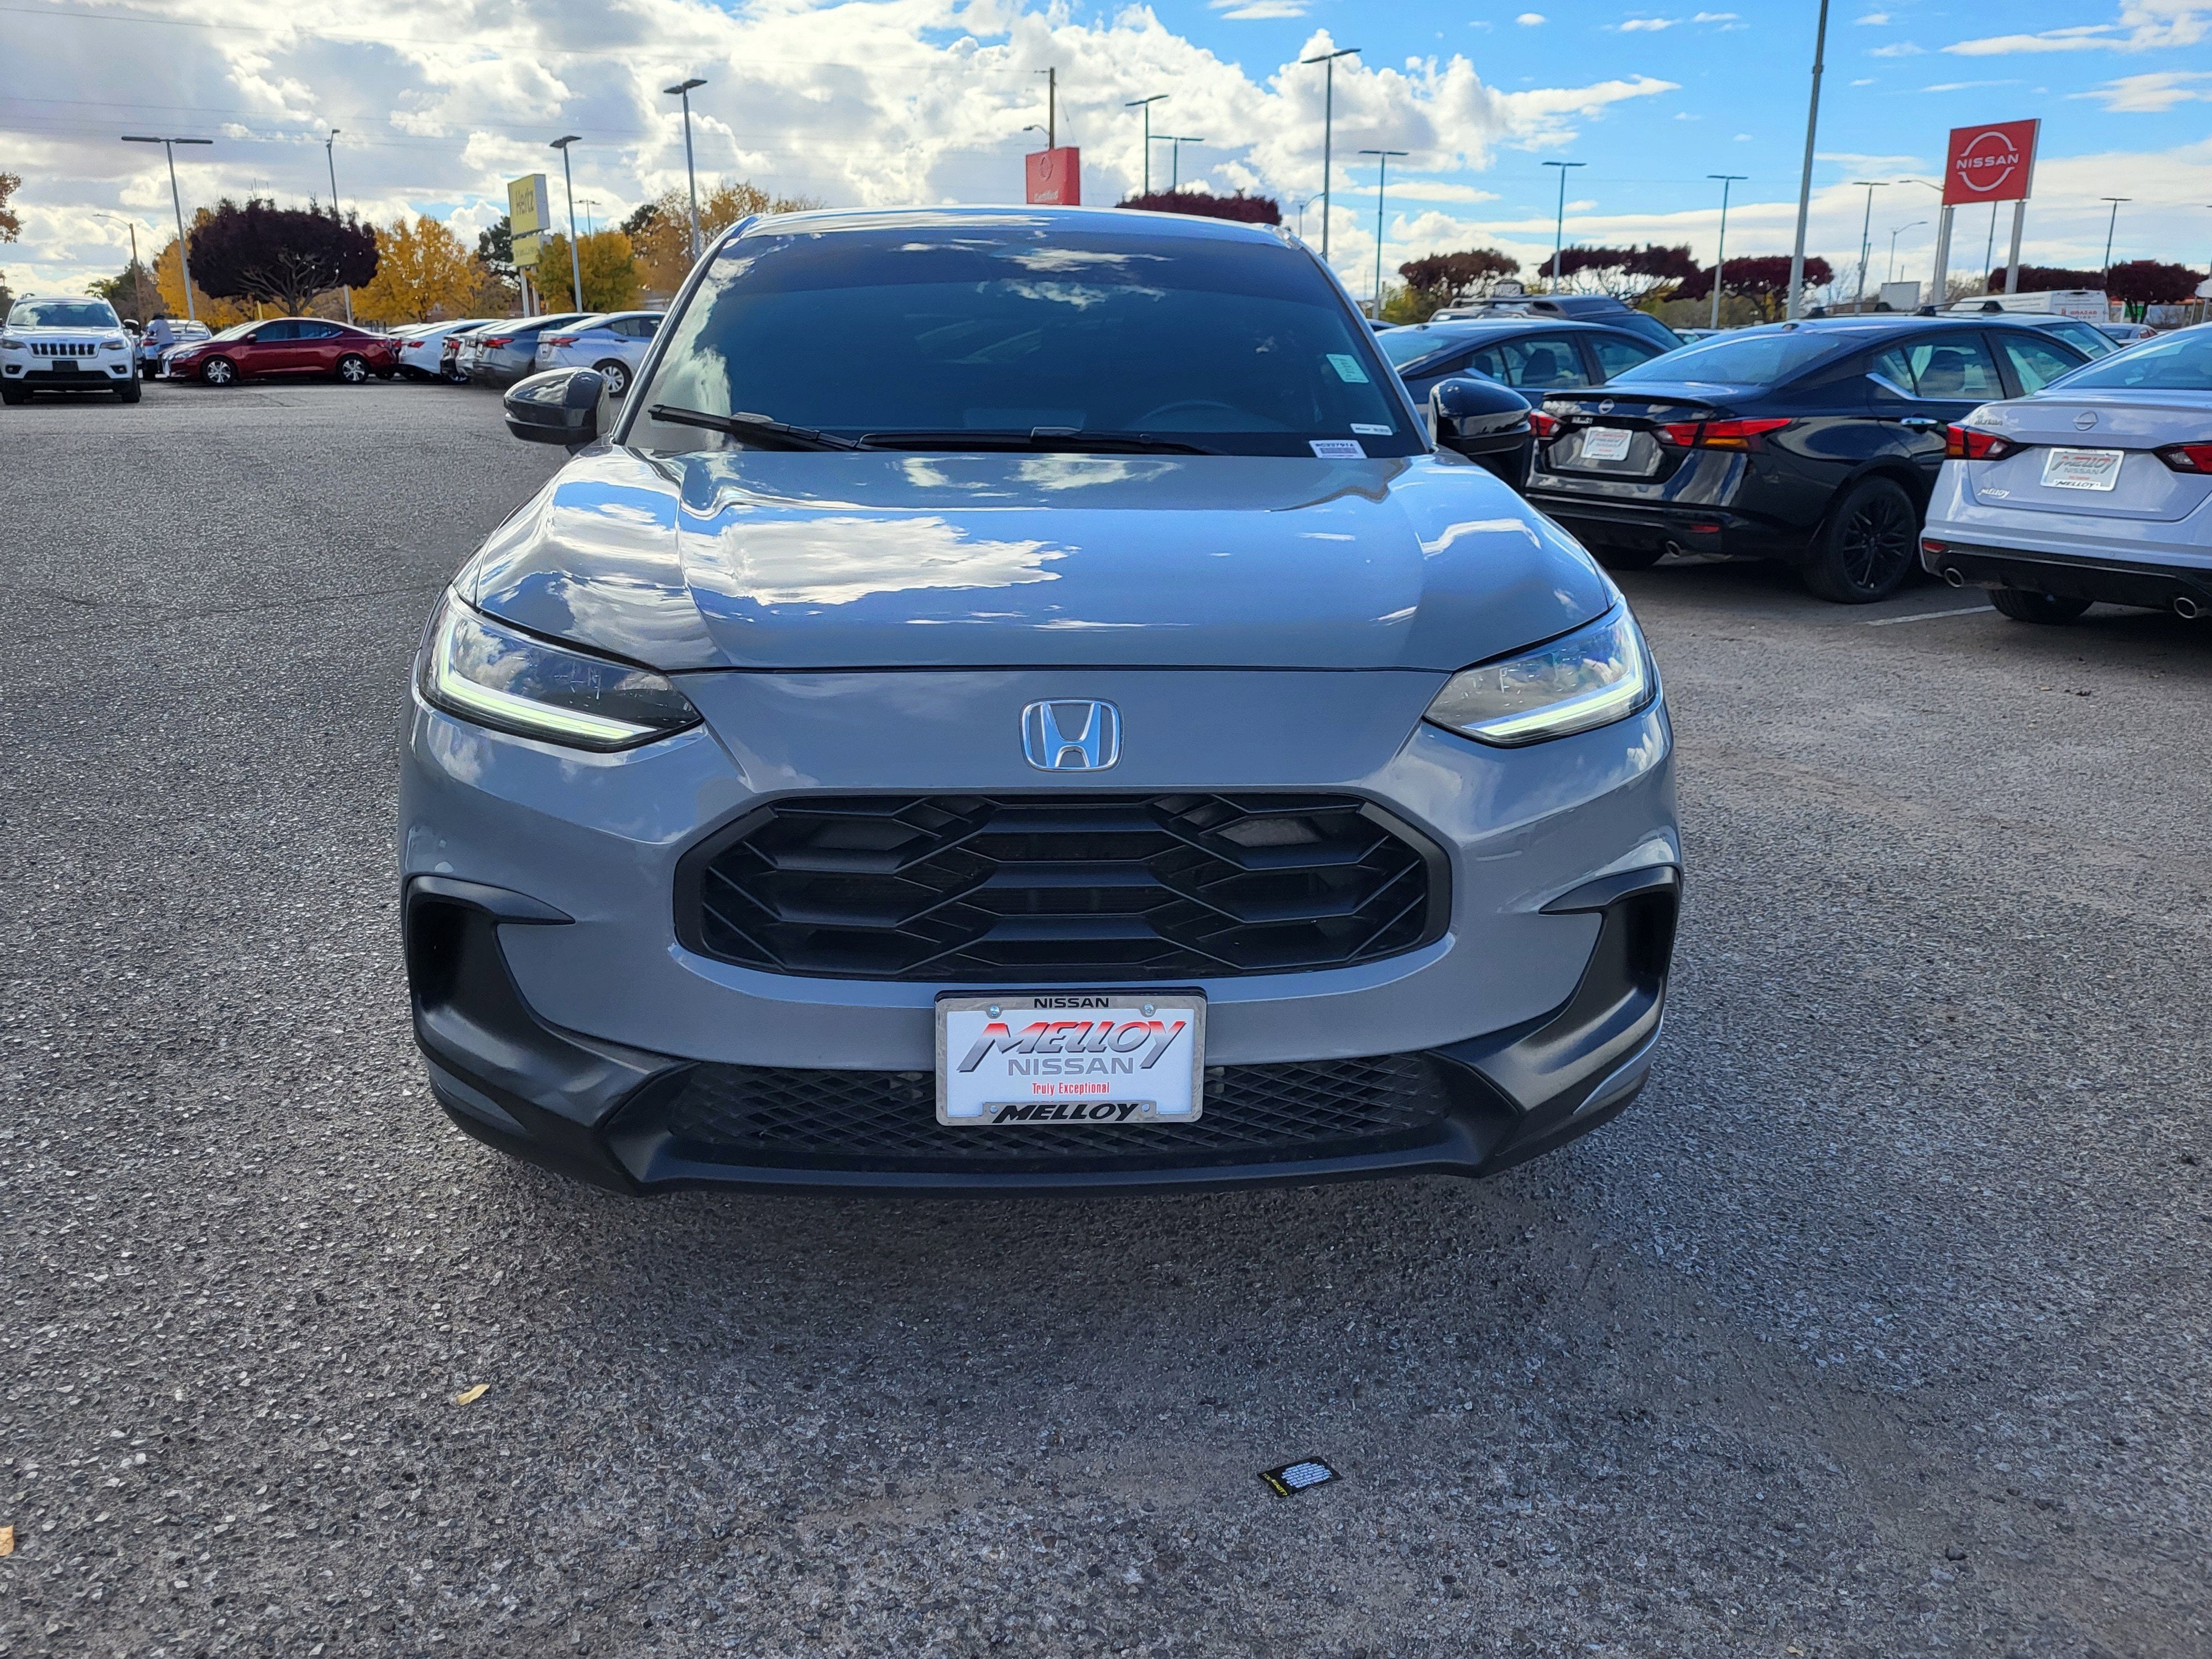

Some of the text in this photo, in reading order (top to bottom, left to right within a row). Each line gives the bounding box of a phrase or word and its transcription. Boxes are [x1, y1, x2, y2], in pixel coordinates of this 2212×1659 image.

[1956, 153, 2019, 169] NISSAN
[1034, 998, 1109, 1008] NISSAN
[956, 1021, 1187, 1073] MELLOY
[1008, 1057, 1134, 1076] NISSAN
[1032, 1082, 1109, 1095] Truly Exceptional
[992, 1103, 1139, 1124] MELLOY
